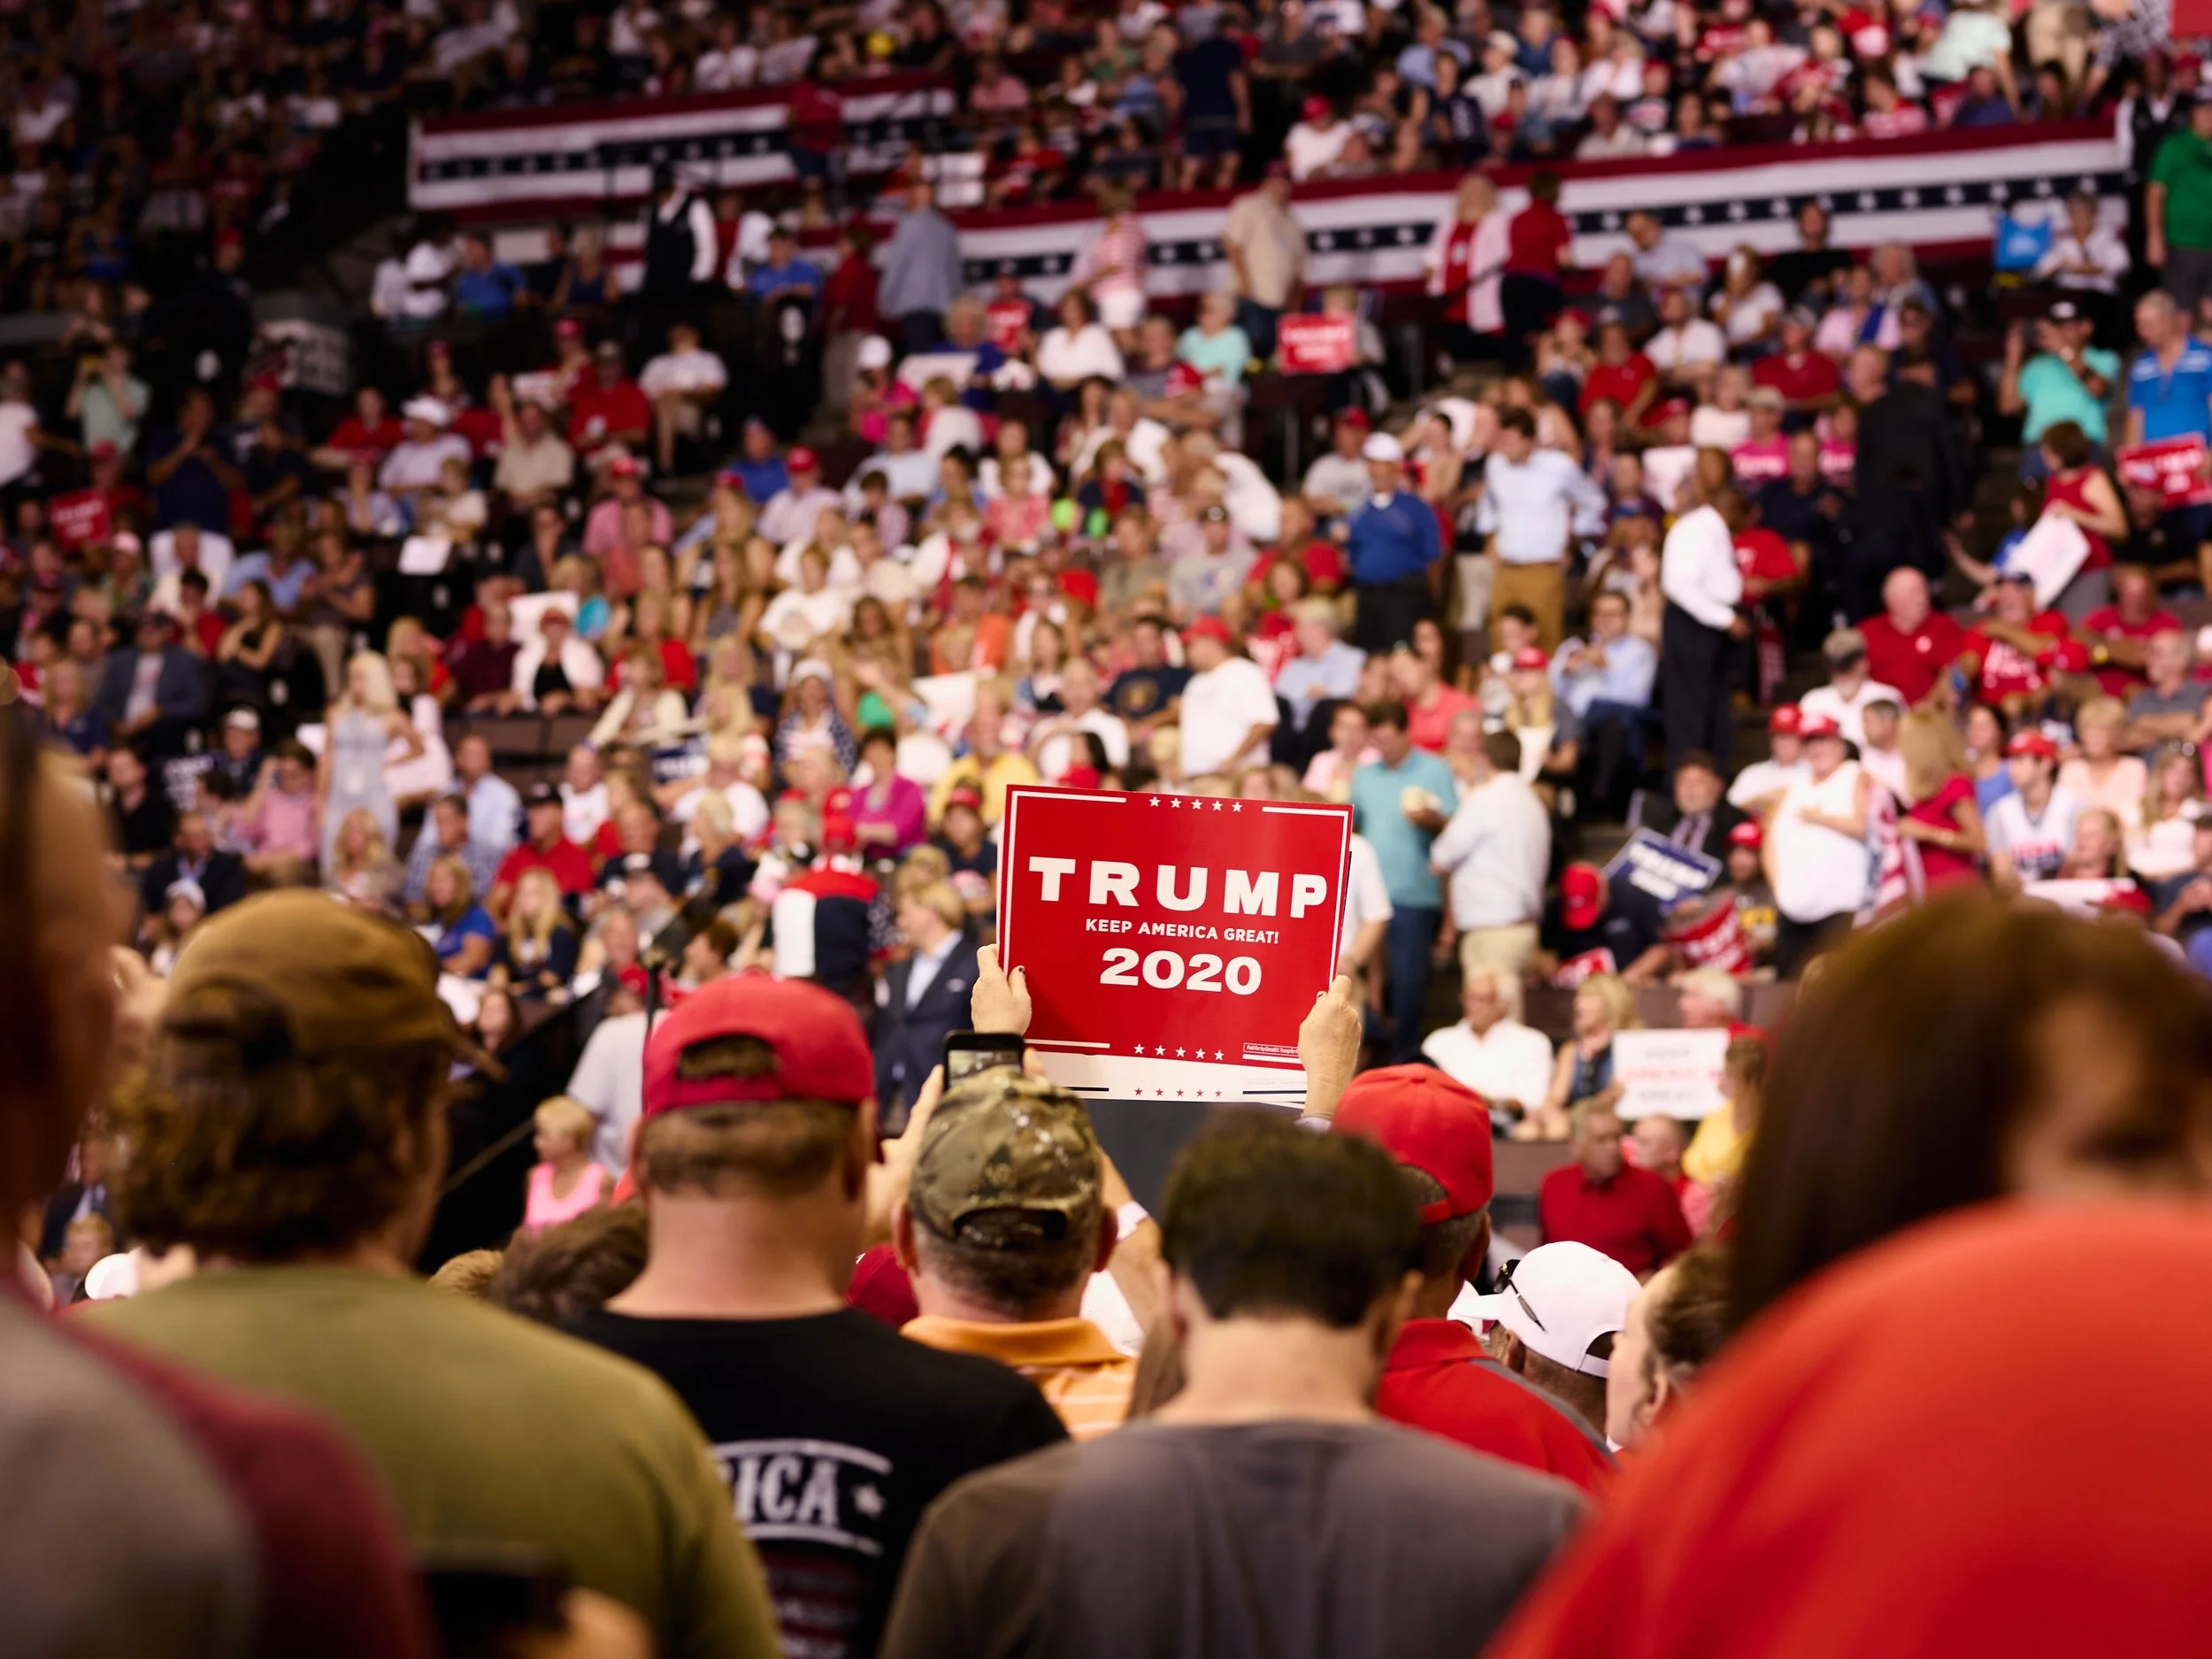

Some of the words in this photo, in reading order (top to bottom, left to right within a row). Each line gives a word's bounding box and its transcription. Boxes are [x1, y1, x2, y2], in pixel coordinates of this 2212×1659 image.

[1029, 856, 1327, 918] TRUMP
[1086, 918, 1133, 933] KEEP
[1138, 922, 1218, 940] AMERICA
[1224, 928, 1279, 944] GREAT!
[1100, 948, 1263, 995] 2020
[718, 1455, 839, 1528] ICA
